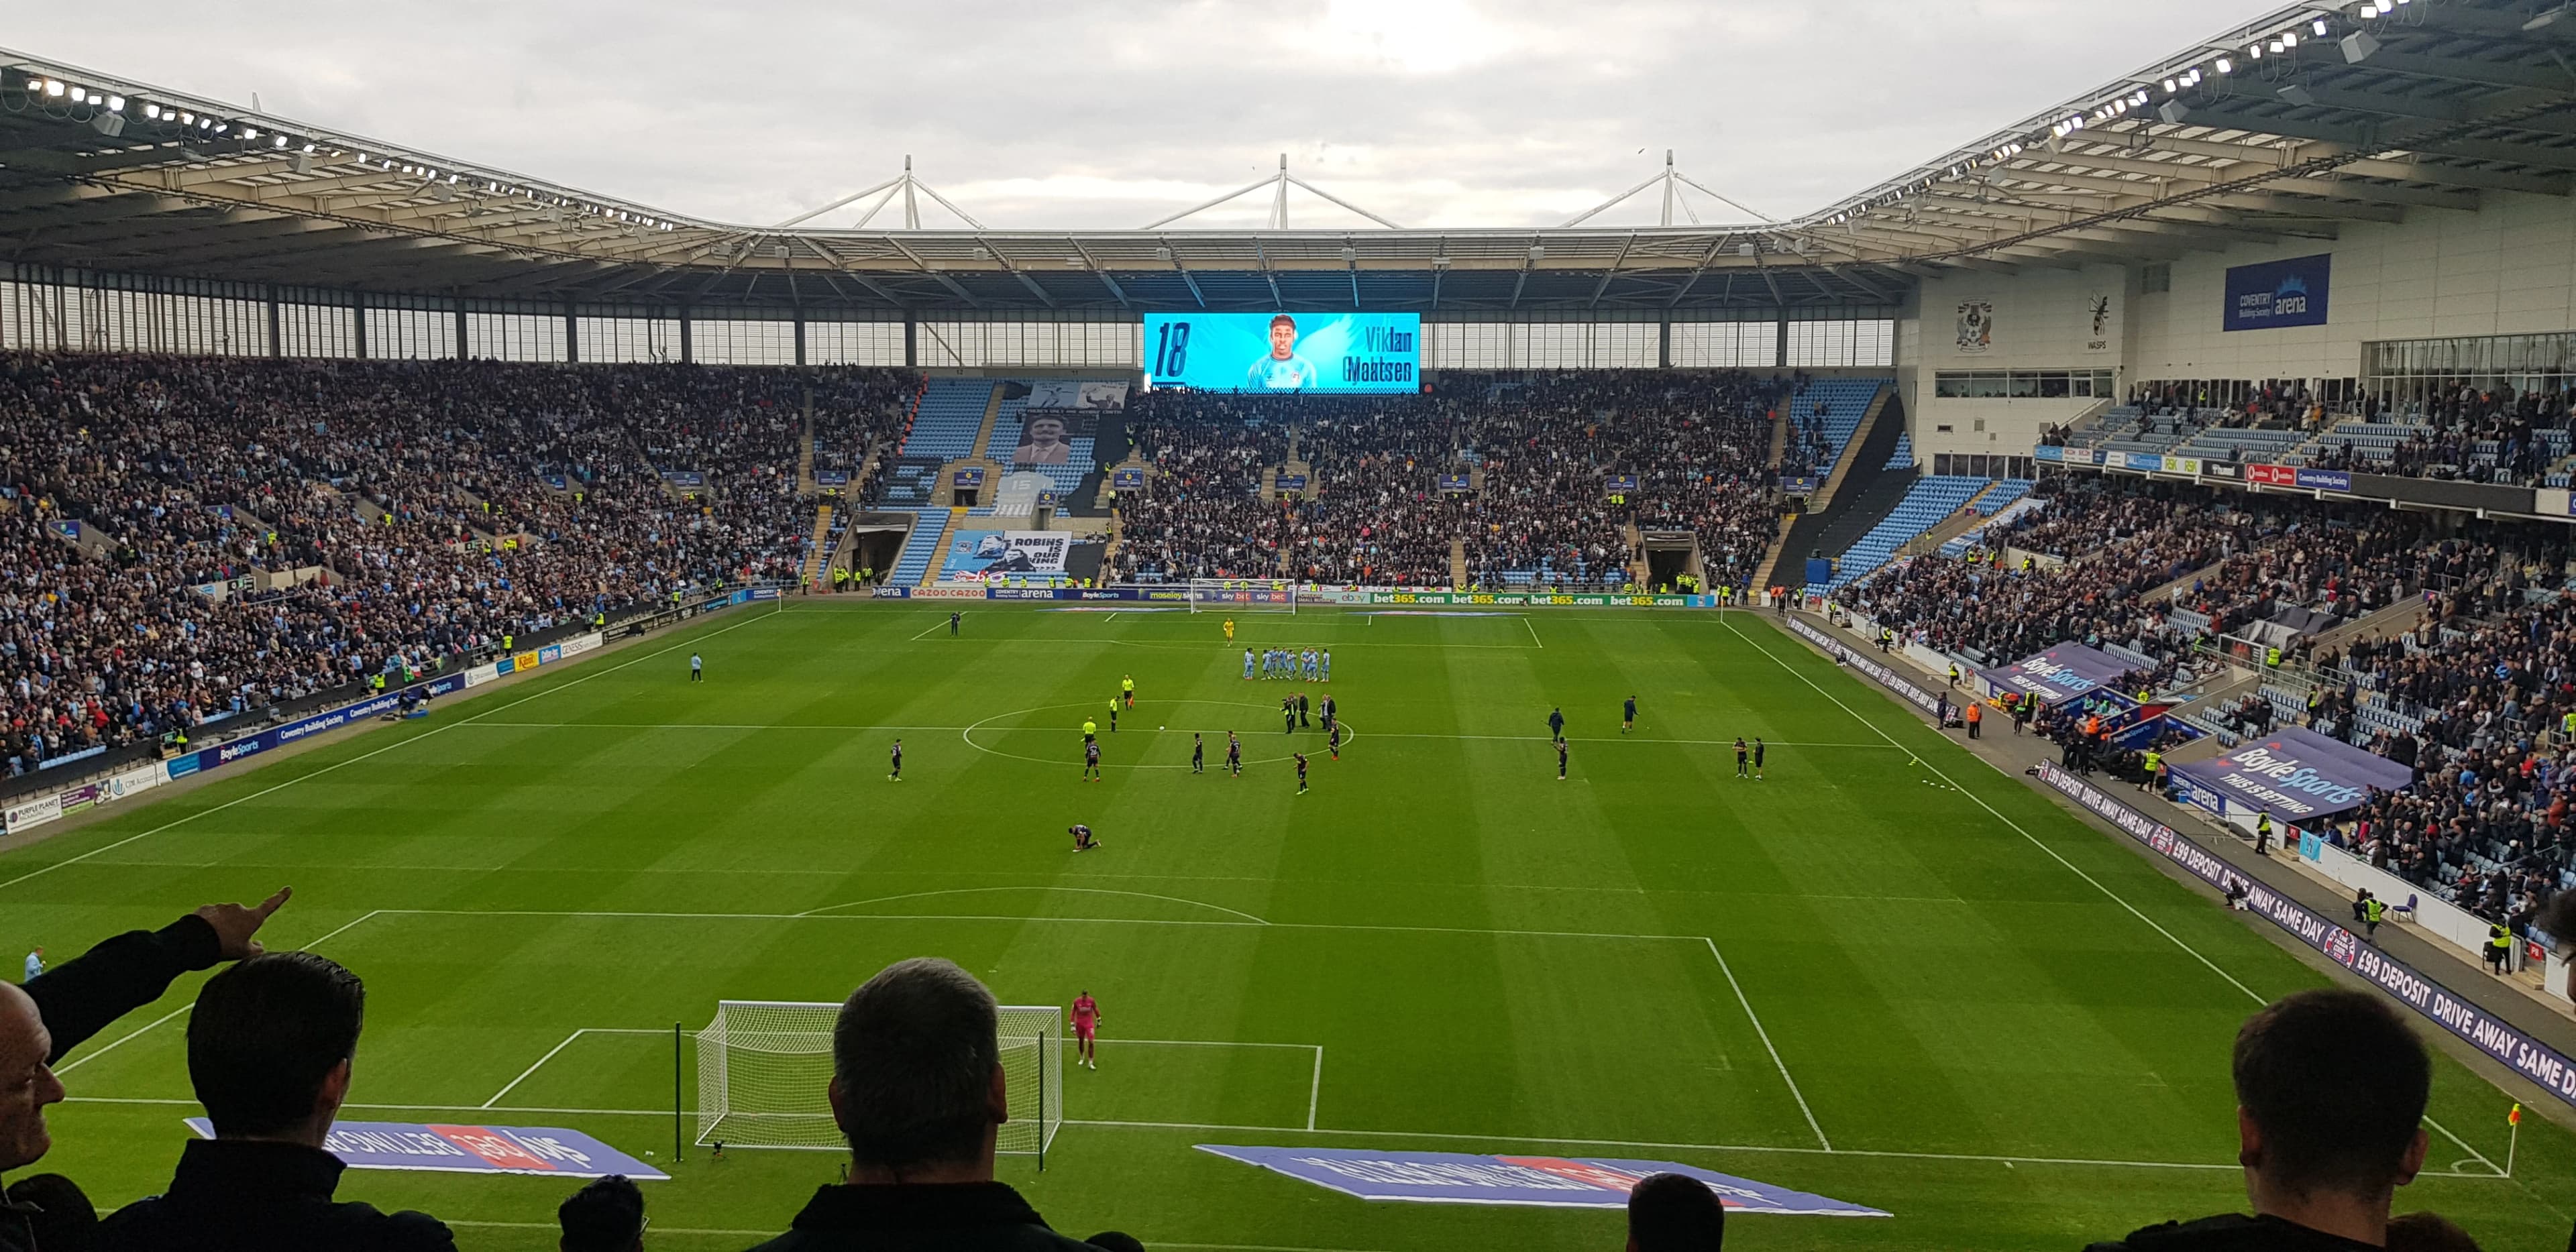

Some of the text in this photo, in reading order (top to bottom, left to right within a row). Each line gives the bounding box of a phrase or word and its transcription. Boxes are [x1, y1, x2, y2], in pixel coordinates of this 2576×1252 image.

[2240, 292, 2272, 307] COVENTRY
[2275, 296, 2306, 315] arena
[1155, 322, 1191, 377] 18
[2088, 340, 2106, 350] WASPS
[2299, 473, 2348, 488] Coventry Building Society
[1022, 589, 1053, 598] arena
[1222, 593, 1234, 601] sky
[1342, 593, 1371, 603] ebay
[1374, 593, 1445, 604] bet365.com
[1452, 594, 1523, 604] bet365.com
[1531, 594, 1603, 605] bet365.com
[1611, 595, 1684, 606] bet365.com
[2022, 657, 2096, 691] BoyleSports
[2027, 684, 2063, 699] BETTING
[350, 707, 371, 718] Coventry
[371, 699, 390, 711] Building
[1927, 697, 1939, 713] SAM
[280, 714, 344, 739] Coventry Building Society
[219, 740, 259, 761] BoyleSports
[2232, 747, 2362, 805] BoyleSports
[2192, 784, 2219, 811] arena
[2219, 773, 2314, 813] THIS IS BETTING
[19, 805, 38, 815] PURPLE
[39, 799, 58, 809] PLANET
[2047, 767, 2153, 839] £99 DEPOSIT DRIVE AWAY SAME DAY
[2173, 840, 2190, 862] £99
[2188, 848, 2222, 882] DEPOSIT
[2248, 885, 2276, 913] AWAY
[2273, 901, 2302, 932] SAME
[2301, 921, 2326, 944] DAY
[2357, 950, 2381, 978] £99
[2379, 960, 2431, 1008] DEPOSIT
[2432, 993, 2473, 1035] DRIVE
[2472, 1019, 2518, 1058] AWAY
[2516, 1041, 2564, 1088] SAME
[343, 1130, 466, 1157] BETTING
[449, 1133, 543, 1165] bet
[502, 1130, 593, 1170] sky
